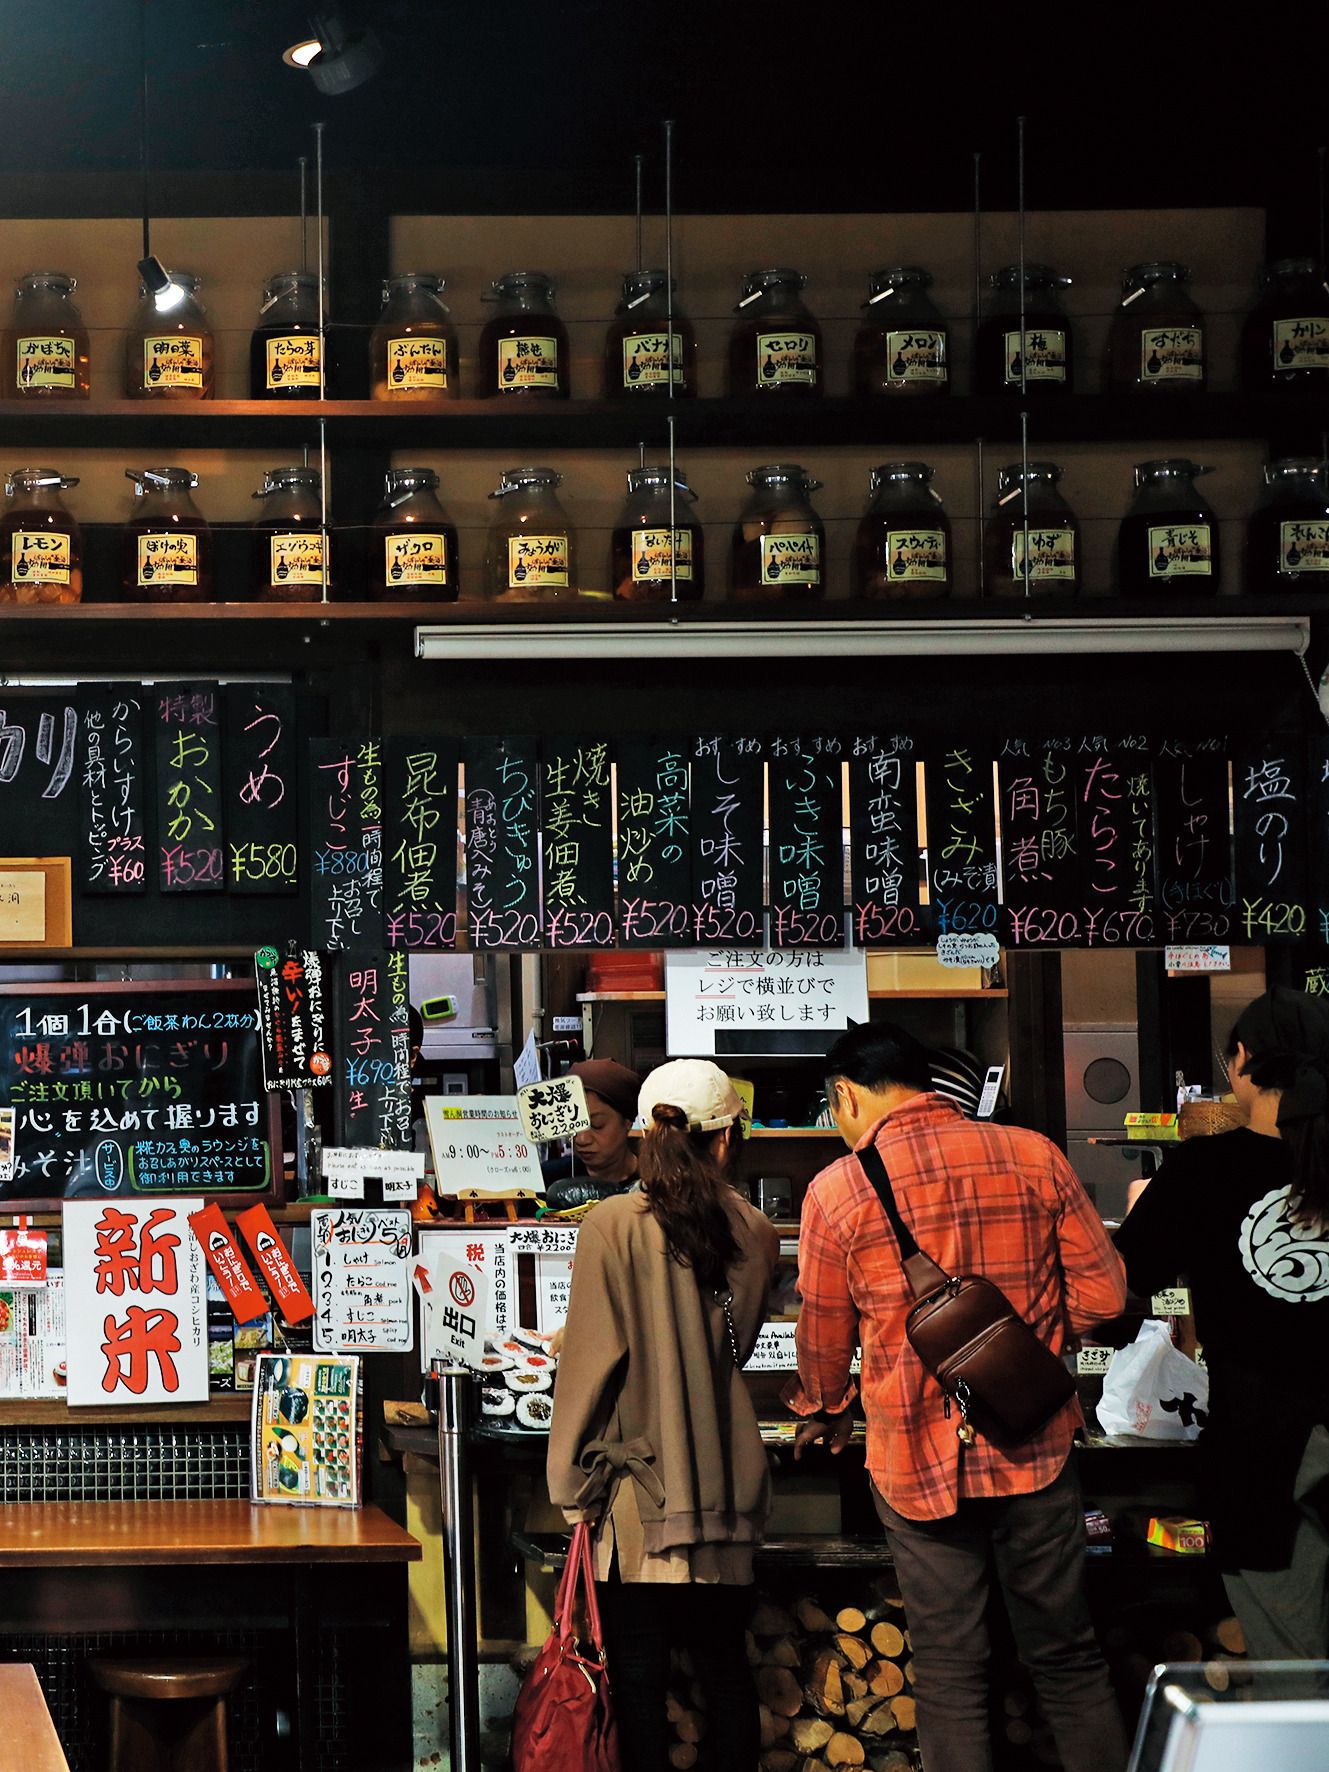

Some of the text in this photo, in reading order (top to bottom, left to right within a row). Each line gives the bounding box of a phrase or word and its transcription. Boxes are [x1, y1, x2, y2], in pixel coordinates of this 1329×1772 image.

[152, 338, 195, 358] 明日葉
[764, 336, 810, 353] セロリ
[900, 334, 937, 350] メロン
[1030, 333, 1049, 351] 梅
[21, 535, 63, 552] レモン
[395, 540, 434, 557] ザクロ
[1161, 529, 1200, 548] 青じそ
[160, 692, 218, 726] 特製
[240, 704, 286, 809] うめ
[168, 729, 215, 841] おかか
[317, 755, 357, 849] すじこ
[654, 751, 690, 864] 高菜の
[941, 749, 984, 864] きざみ
[1041, 751, 1077, 862] もち豚
[390, 752, 447, 913] 昆布佃煮
[545, 757, 588, 905] 生姜佃煮
[620, 787, 657, 883] 油炒め
[700, 751, 745, 909] しそ味噌
[778, 754, 835, 911] ふき味噌
[865, 749, 904, 906] 南蛮味噌
[1008, 777, 1053, 882] 角煮
[1084, 757, 1123, 893] たらこ
[1181, 764, 1211, 880] しゃけ
[1243, 758, 1297, 887] 塩のり
[108, 836, 145, 852] プラス
[707, 950, 825, 968] ご注文の方は
[699, 976, 836, 995] レジで横並びで
[349, 969, 381, 1056] 明太子
[696, 1003, 837, 1022] お願い致します
[13, 1040, 229, 1076] 爆弾おにぎり
[10, 1076, 183, 1104] ご注文頂いてから
[529, 1103, 579, 1130] おにぎり
[101, 1143, 116, 1187] サービス中
[138, 1155, 264, 1171] お召しあがりスペースとして
[139, 1170, 236, 1186] 御利用できます
[331, 1178, 358, 1190] すじこ
[385, 1180, 413, 1192] 明太子
[343, 1252, 370, 1266] しゃけ
[346, 1273, 373, 1288] たらこ
[94, 1207, 182, 1395] 新米
[346, 1307, 376, 1323] すじこ
[443, 1306, 476, 1339] 出口
[341, 1327, 377, 1344] 明太子
[450, 1335, 465, 1349] Exit
[1081, 1348, 1111, 1362] きざみ
[1180, 1536, 1205, 1548] 100
